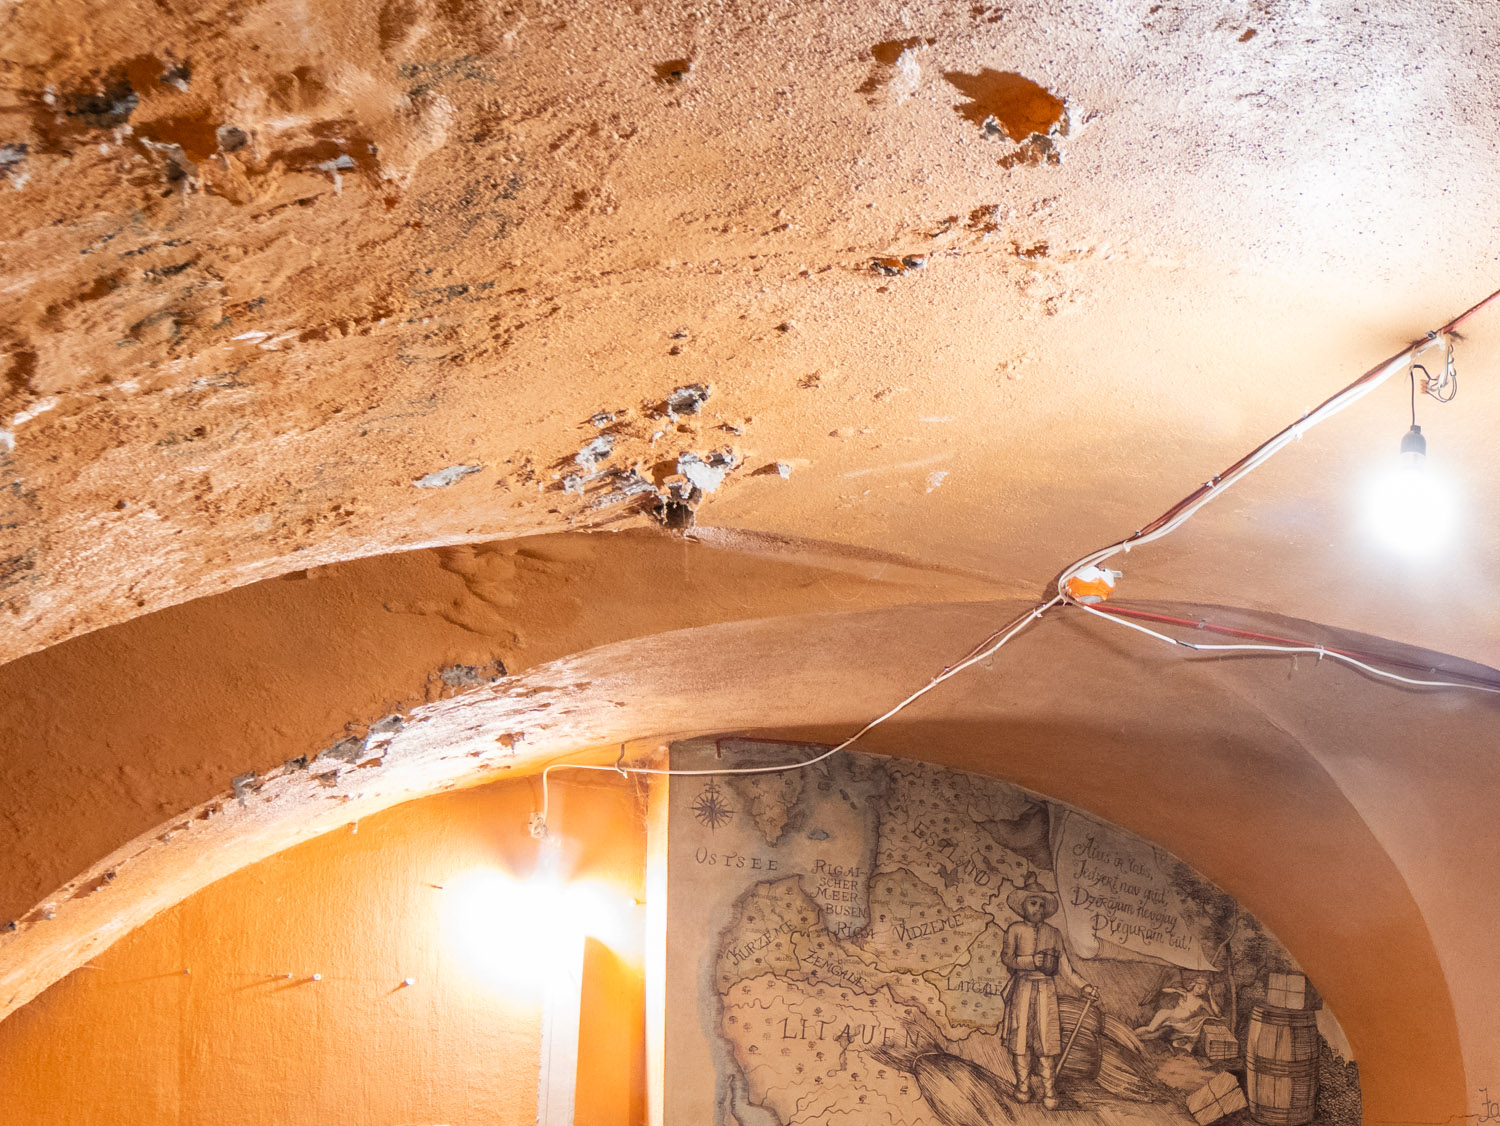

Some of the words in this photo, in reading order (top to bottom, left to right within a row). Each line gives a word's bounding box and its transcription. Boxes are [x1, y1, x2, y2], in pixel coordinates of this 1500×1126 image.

[819, 877, 858, 890] SCHER
[825, 903, 868, 918] BUSEN
[894, 914, 964, 942] VIDZEME
[726, 920, 797, 966] KURZEME
[776, 1015, 920, 1048] LITAUEN
